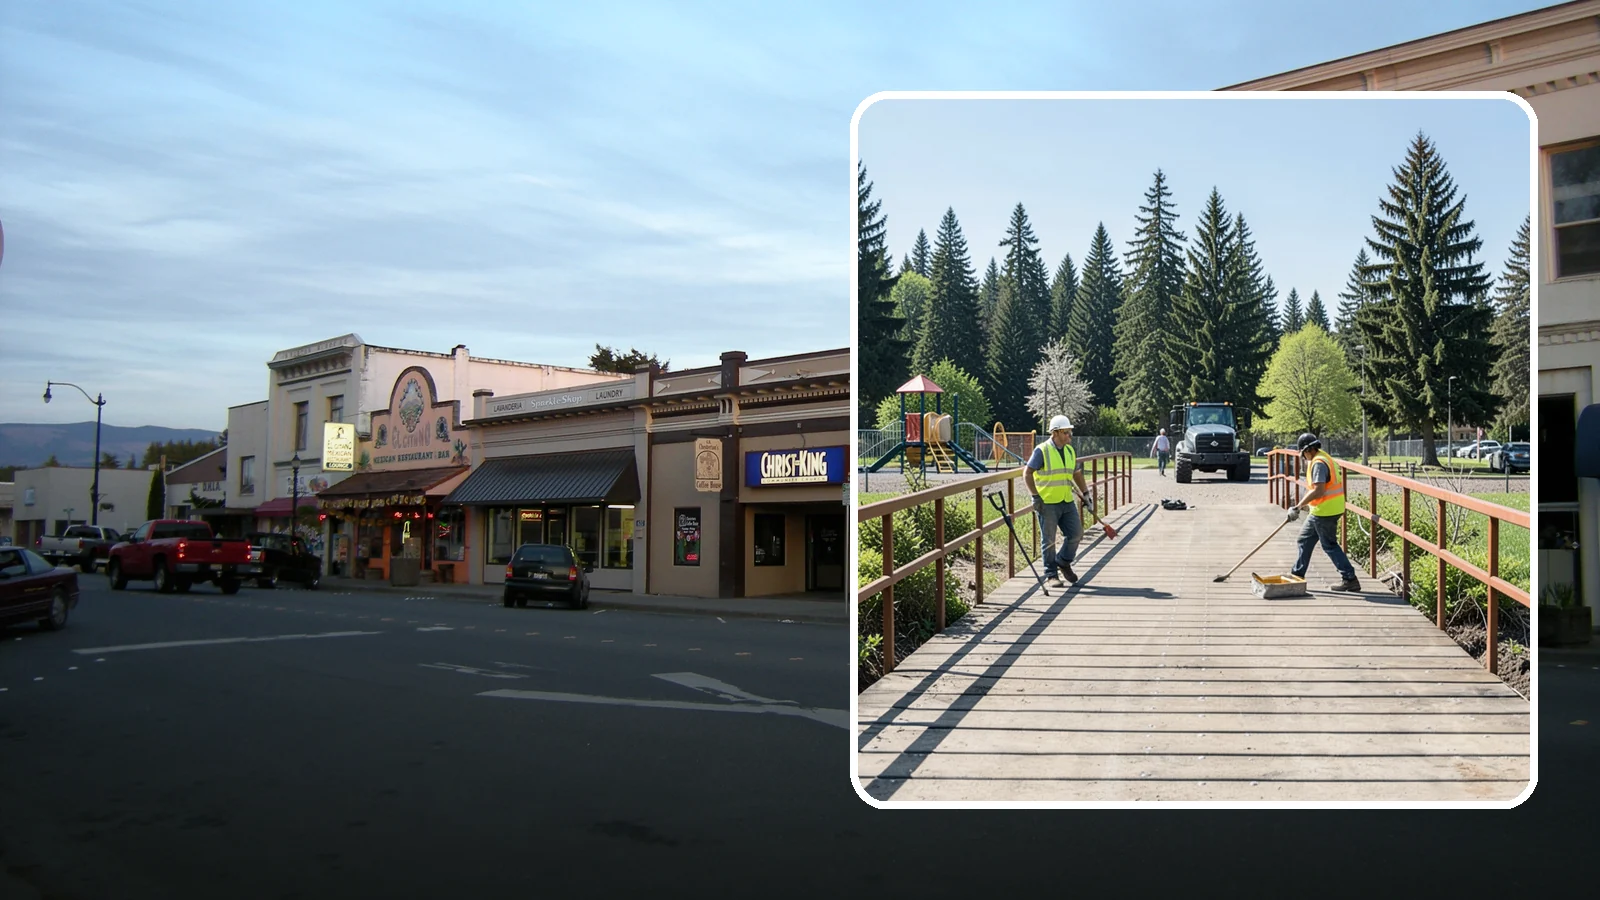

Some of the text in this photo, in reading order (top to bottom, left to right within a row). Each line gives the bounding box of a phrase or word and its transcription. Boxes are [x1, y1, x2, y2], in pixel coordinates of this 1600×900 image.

[494, 402, 522, 412] LAVANDERIA
[562, 394, 582, 405] Shop
[595, 388, 623, 400] LAUNDRY
[397, 451, 433, 462] RESTAURANT
[438, 450, 450, 459] BAR
[761, 450, 827, 478] CHRIST KING
[697, 481, 709, 489] Coffee
